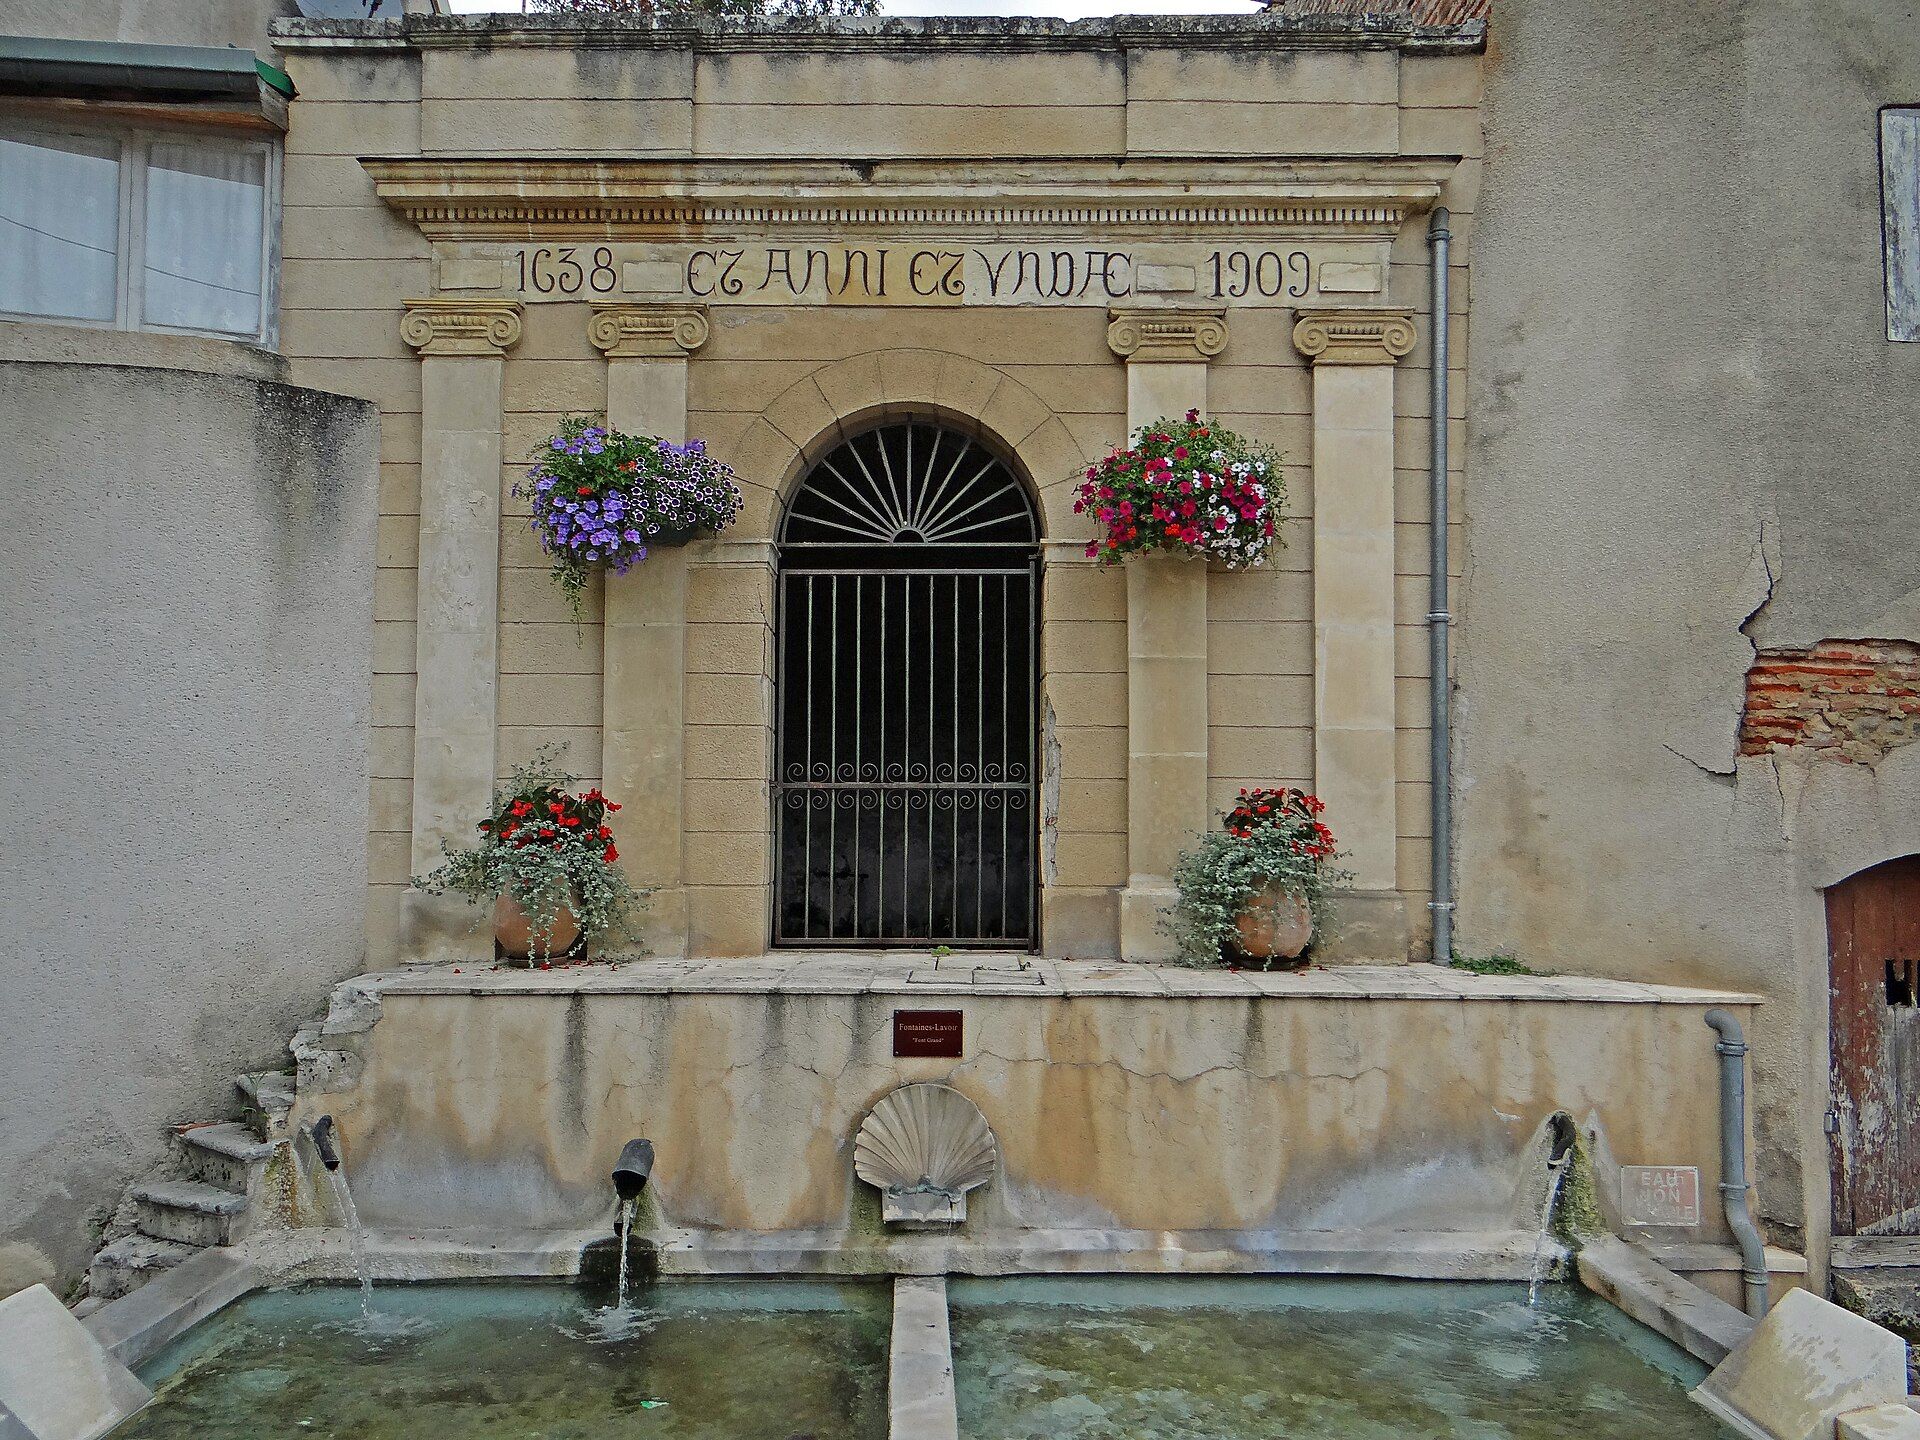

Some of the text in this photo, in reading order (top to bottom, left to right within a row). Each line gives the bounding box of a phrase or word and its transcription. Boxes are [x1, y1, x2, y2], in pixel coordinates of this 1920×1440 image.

[514, 246, 617, 293] 1638
[756, 248, 889, 297] ANNI
[1205, 250, 1310, 298] 1909
[1641, 1171, 1679, 1188] EAU
